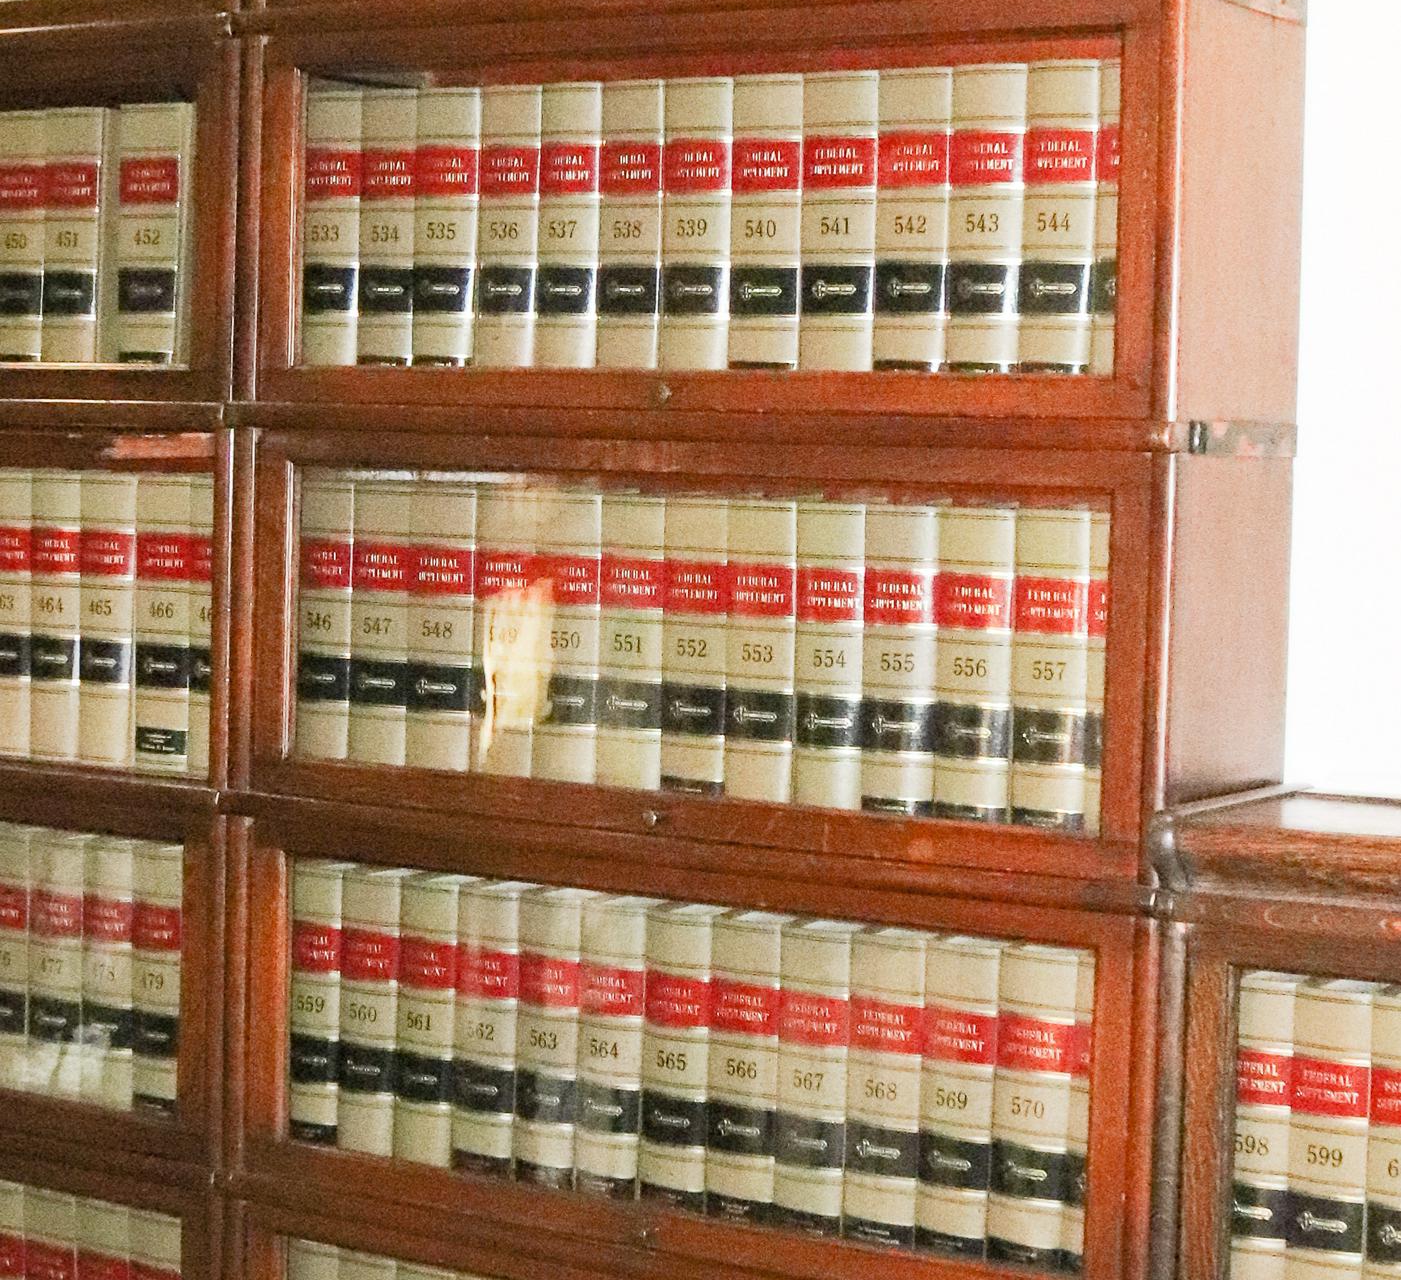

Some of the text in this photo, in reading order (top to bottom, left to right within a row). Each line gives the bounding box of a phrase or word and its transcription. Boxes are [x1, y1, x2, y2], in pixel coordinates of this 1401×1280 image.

[815, 147, 858, 159] FEDERAL
[1036, 157, 1087, 169] UPPLEMENT
[743, 166, 789, 178] UPPLEMENT
[549, 221, 577, 238] 537
[613, 221, 641, 238] 538
[677, 219, 707, 236] 539
[745, 220, 776, 237] 540
[821, 217, 850, 234] 541
[894, 216, 926, 233] 542
[966, 214, 999, 231] 543
[1037, 212, 1070, 231] 544
[133, 230, 160, 245] 452
[311, 224, 339, 241] 533
[372, 224, 398, 241] 534
[427, 222, 455, 239] 535
[490, 222, 517, 239] 536
[418, 571, 464, 583] UPPLEMENT
[611, 583, 656, 596] UPPLEMENT
[736, 590, 785, 603] UPPLEMENT
[876, 582, 923, 595] FEDERAL
[150, 602, 173, 618] 466
[807, 596, 860, 609] UPPLEMENT
[307, 614, 331, 630] 546
[363, 616, 391, 634] 547
[422, 621, 452, 638] 548
[551, 631, 580, 648] 550
[614, 634, 642, 653] 551
[677, 639, 706, 657] 552
[742, 644, 772, 662] 553
[813, 649, 846, 668] 554
[881, 654, 914, 672] 555
[953, 658, 987, 677] 556
[1033, 661, 1066, 680] 557
[297, 994, 324, 1012] 559
[350, 1003, 376, 1022] 560
[863, 1010, 904, 1025] FEDERAL
[407, 1013, 431, 1031] 561
[530, 1030, 557, 1049] 563
[590, 1038, 618, 1058] 564
[657, 1050, 686, 1071] 565
[726, 1060, 757, 1079] 566
[1303, 1069, 1352, 1087] FEDERAL
[793, 1072, 824, 1091] 567
[865, 1080, 897, 1100] 568
[936, 1089, 968, 1109] 569
[1011, 1098, 1044, 1119] 570
[1234, 1134, 1269, 1156] 598
[1307, 1146, 1343, 1168] 599
